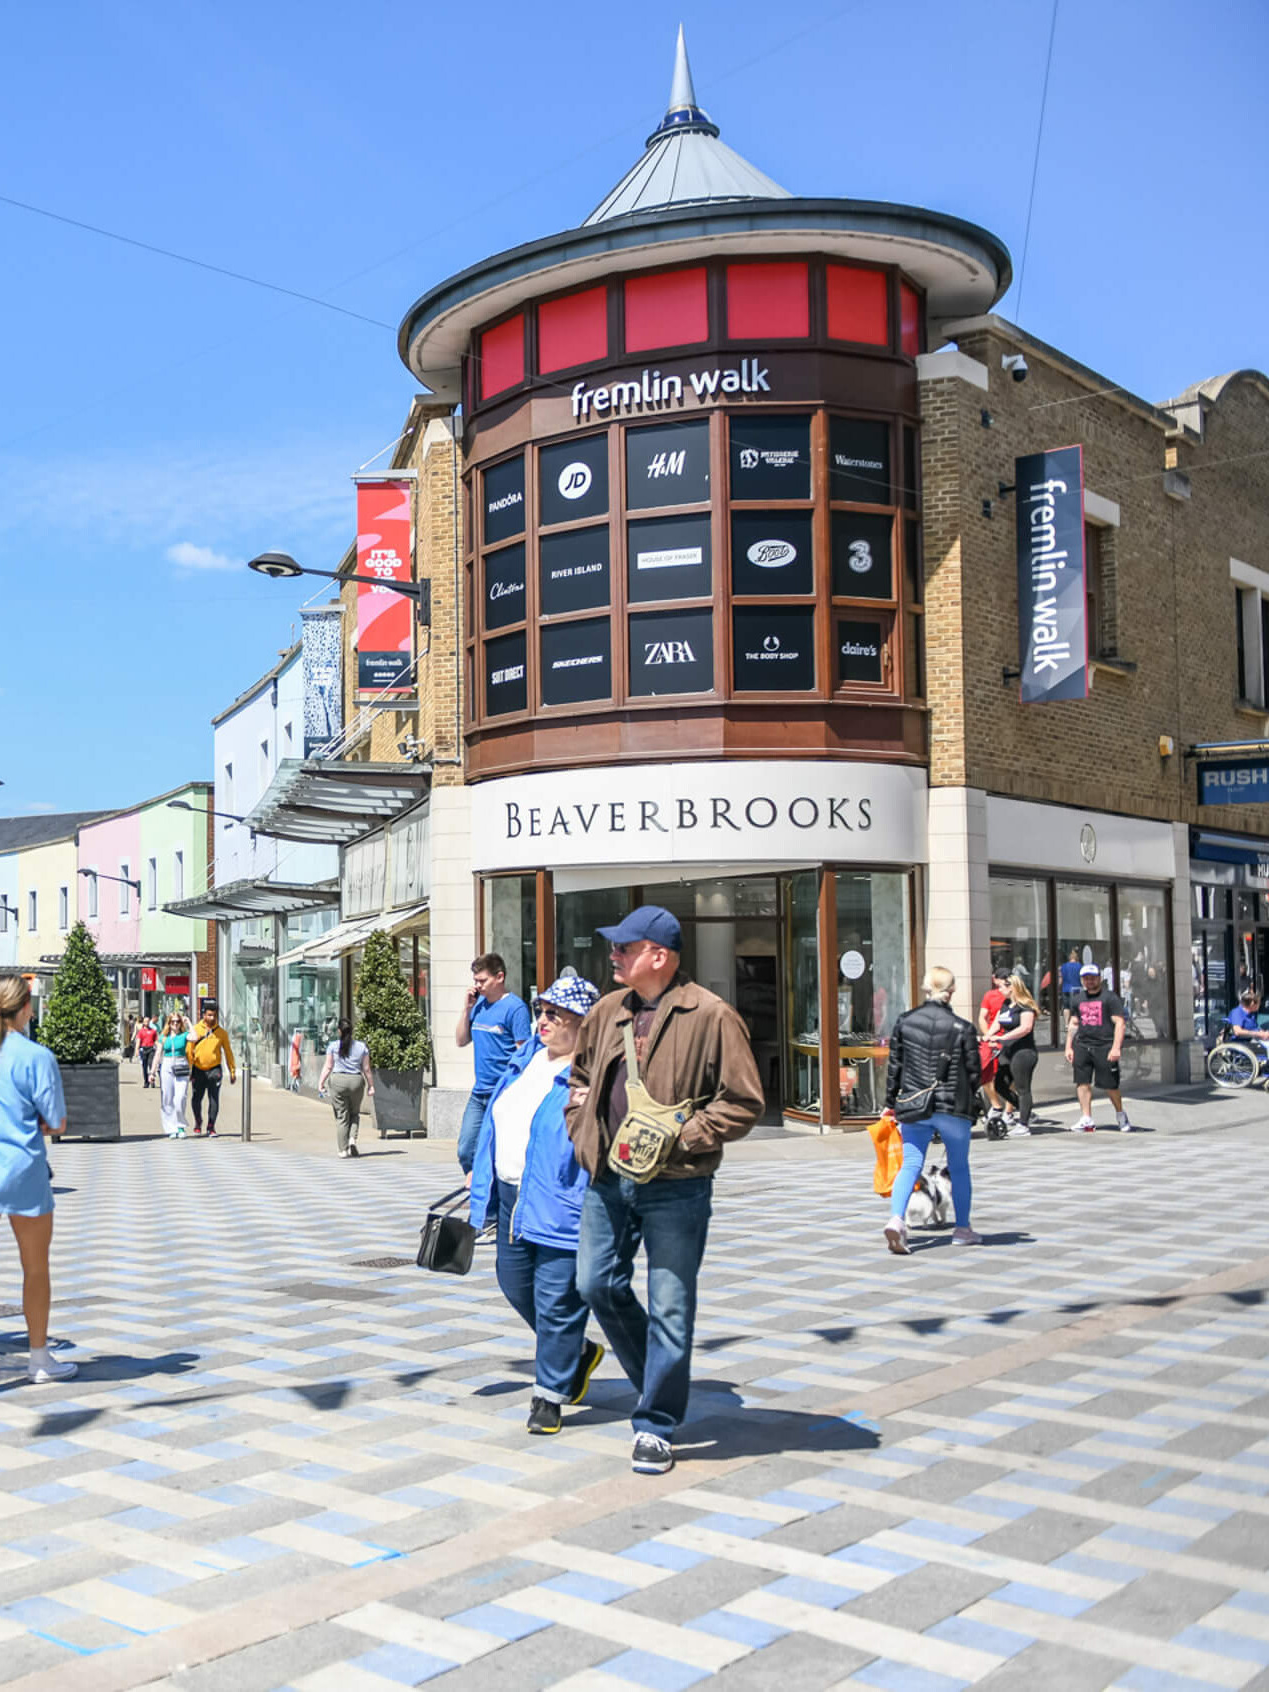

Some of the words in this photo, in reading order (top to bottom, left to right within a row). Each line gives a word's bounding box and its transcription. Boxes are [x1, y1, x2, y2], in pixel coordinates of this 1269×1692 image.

[570, 369, 682, 416] fremlin
[689, 358, 771, 395] walk
[647, 450, 686, 479] H&M
[834, 454, 883, 469] Waterstones
[564, 472, 586, 491] JD
[1030, 479, 1068, 592] fremlin
[365, 558, 402, 568] GOOD
[755, 544, 790, 562] Boots
[848, 539, 873, 573] 3
[374, 568, 393, 576] TO
[551, 568, 572, 579] RIVER
[574, 563, 603, 576] ISLAND
[1032, 596, 1071, 675] walk
[644, 640, 697, 665] ZARA
[841, 641, 877, 656] claire's
[1203, 767, 1268, 787] RUSH
[506, 797, 873, 838] BEAVERBROOKS
